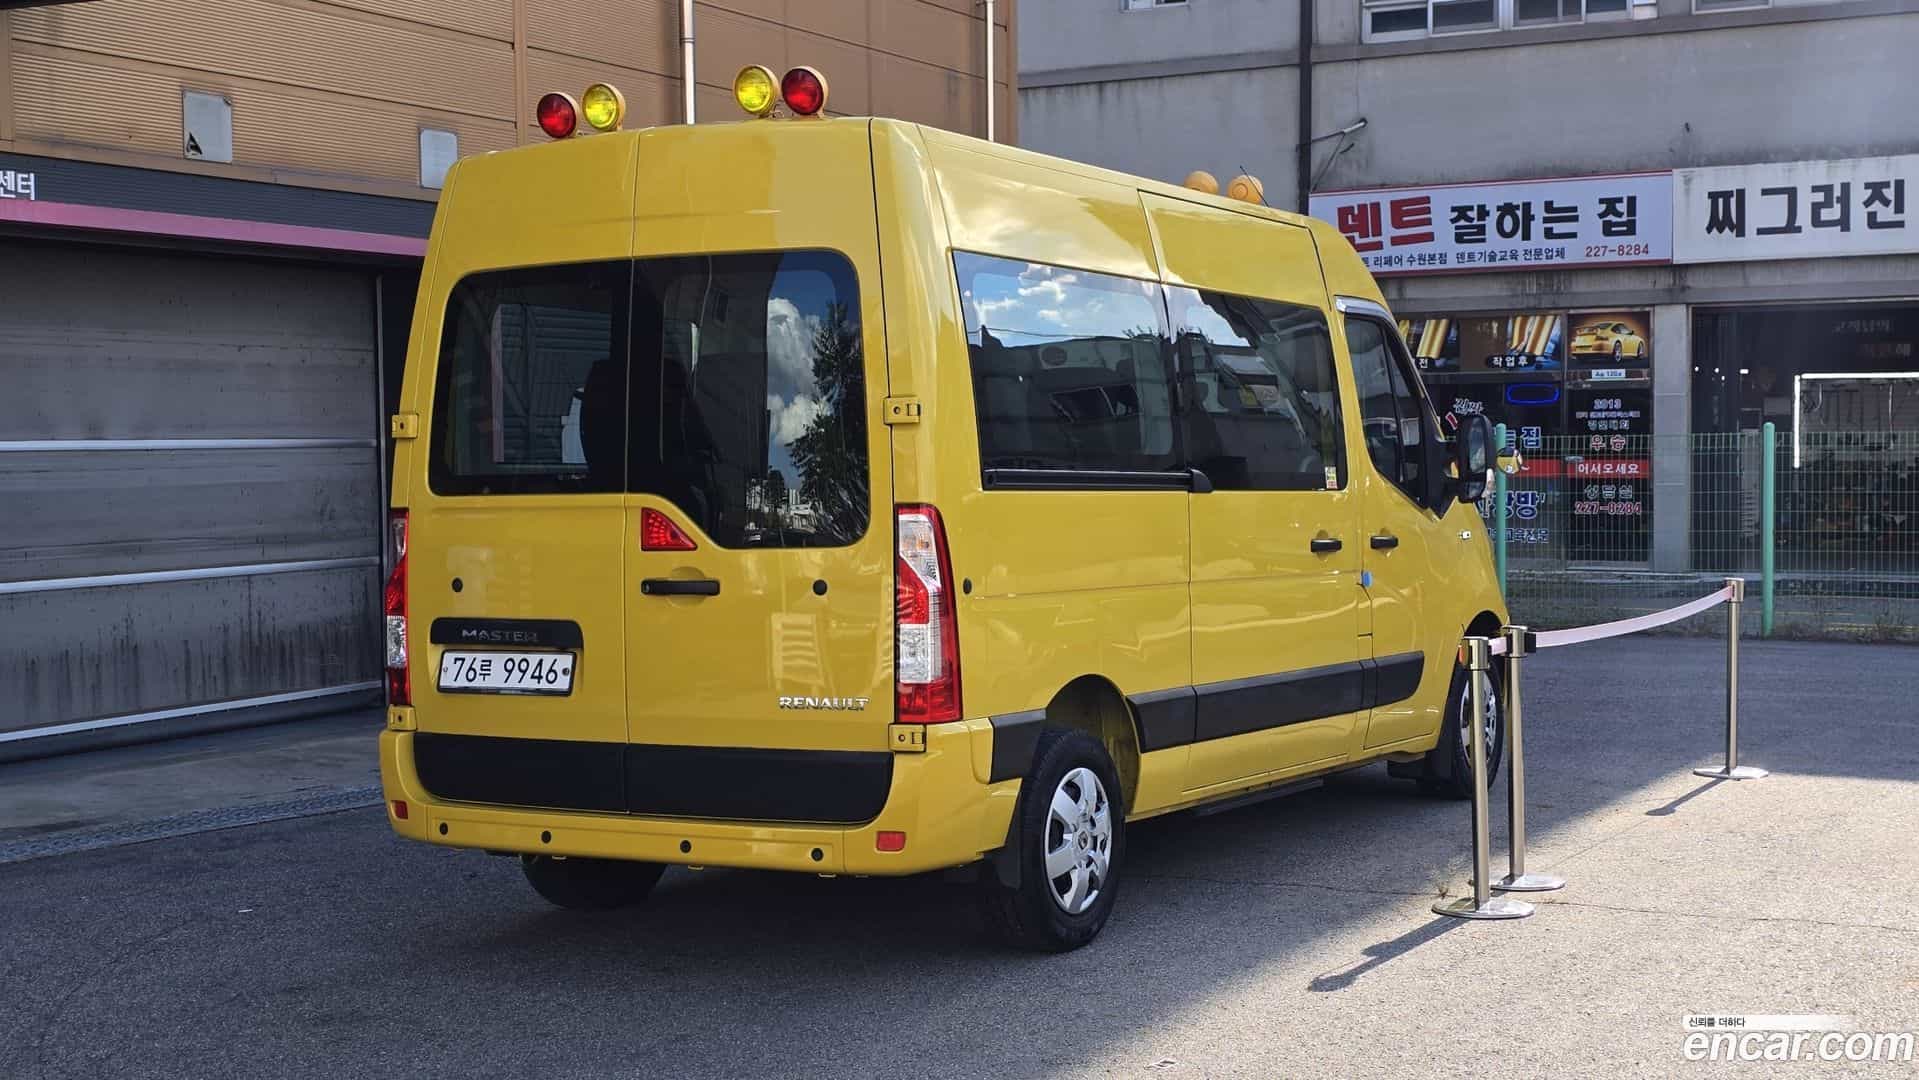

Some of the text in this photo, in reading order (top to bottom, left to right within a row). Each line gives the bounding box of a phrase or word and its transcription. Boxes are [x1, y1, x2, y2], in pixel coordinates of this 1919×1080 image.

[0, 169, 36, 201] 센터
[1705, 178, 1905, 239] 찌그러진
[1337, 195, 1638, 253] 덴트 잘하는 집
[1374, 253, 1404, 268] 리페어
[1407, 251, 1448, 266] 수원본점
[1456, 246, 1519, 264] 덴트기술교육
[1523, 245, 1566, 262] 전문업체
[1585, 243, 1650, 258] 227-8284
[1578, 463, 1640, 475] 어서오세요
[1574, 501, 1642, 515] 227-8284
[453, 657, 558, 684] 76루 9946
[779, 696, 869, 711] RENAULT
